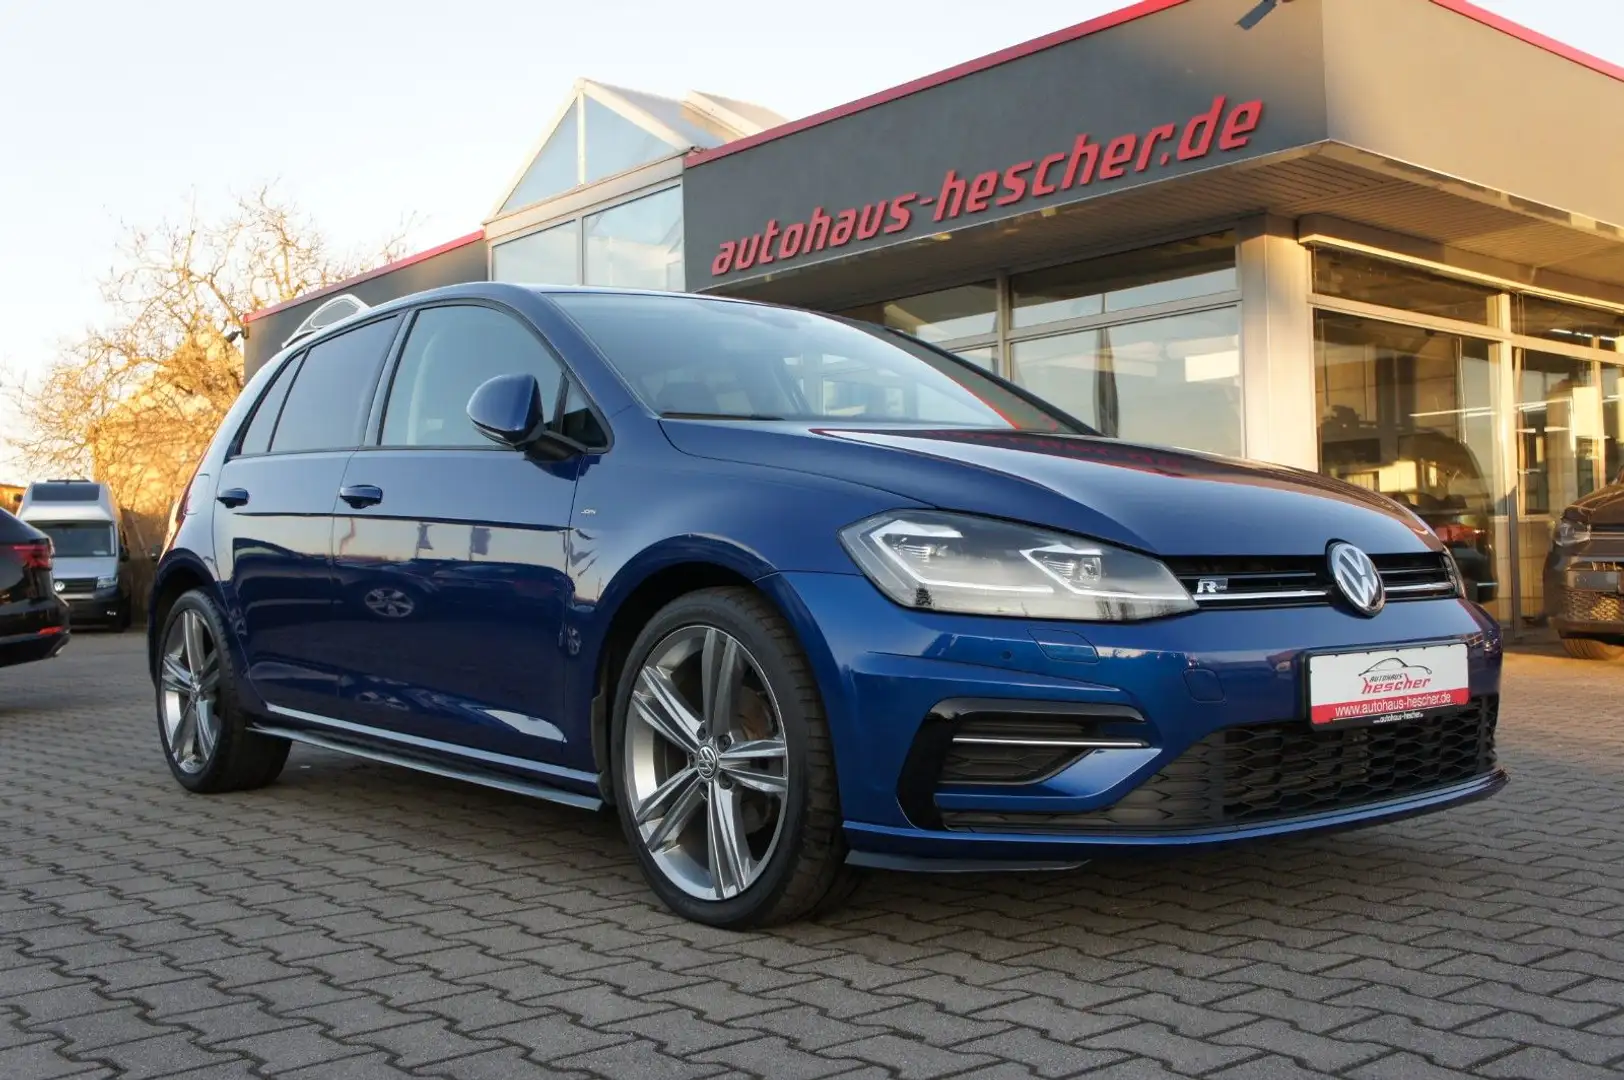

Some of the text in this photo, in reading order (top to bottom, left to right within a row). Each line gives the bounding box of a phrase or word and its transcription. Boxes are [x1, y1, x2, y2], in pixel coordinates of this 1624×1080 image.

[711, 95, 1263, 276] autohaus-hescher.de
[1361, 673, 1432, 695] hescher
[1369, 673, 1403, 683] AUTOHAUS
[1335, 692, 1451, 717] www.autohaus-hescher.de
